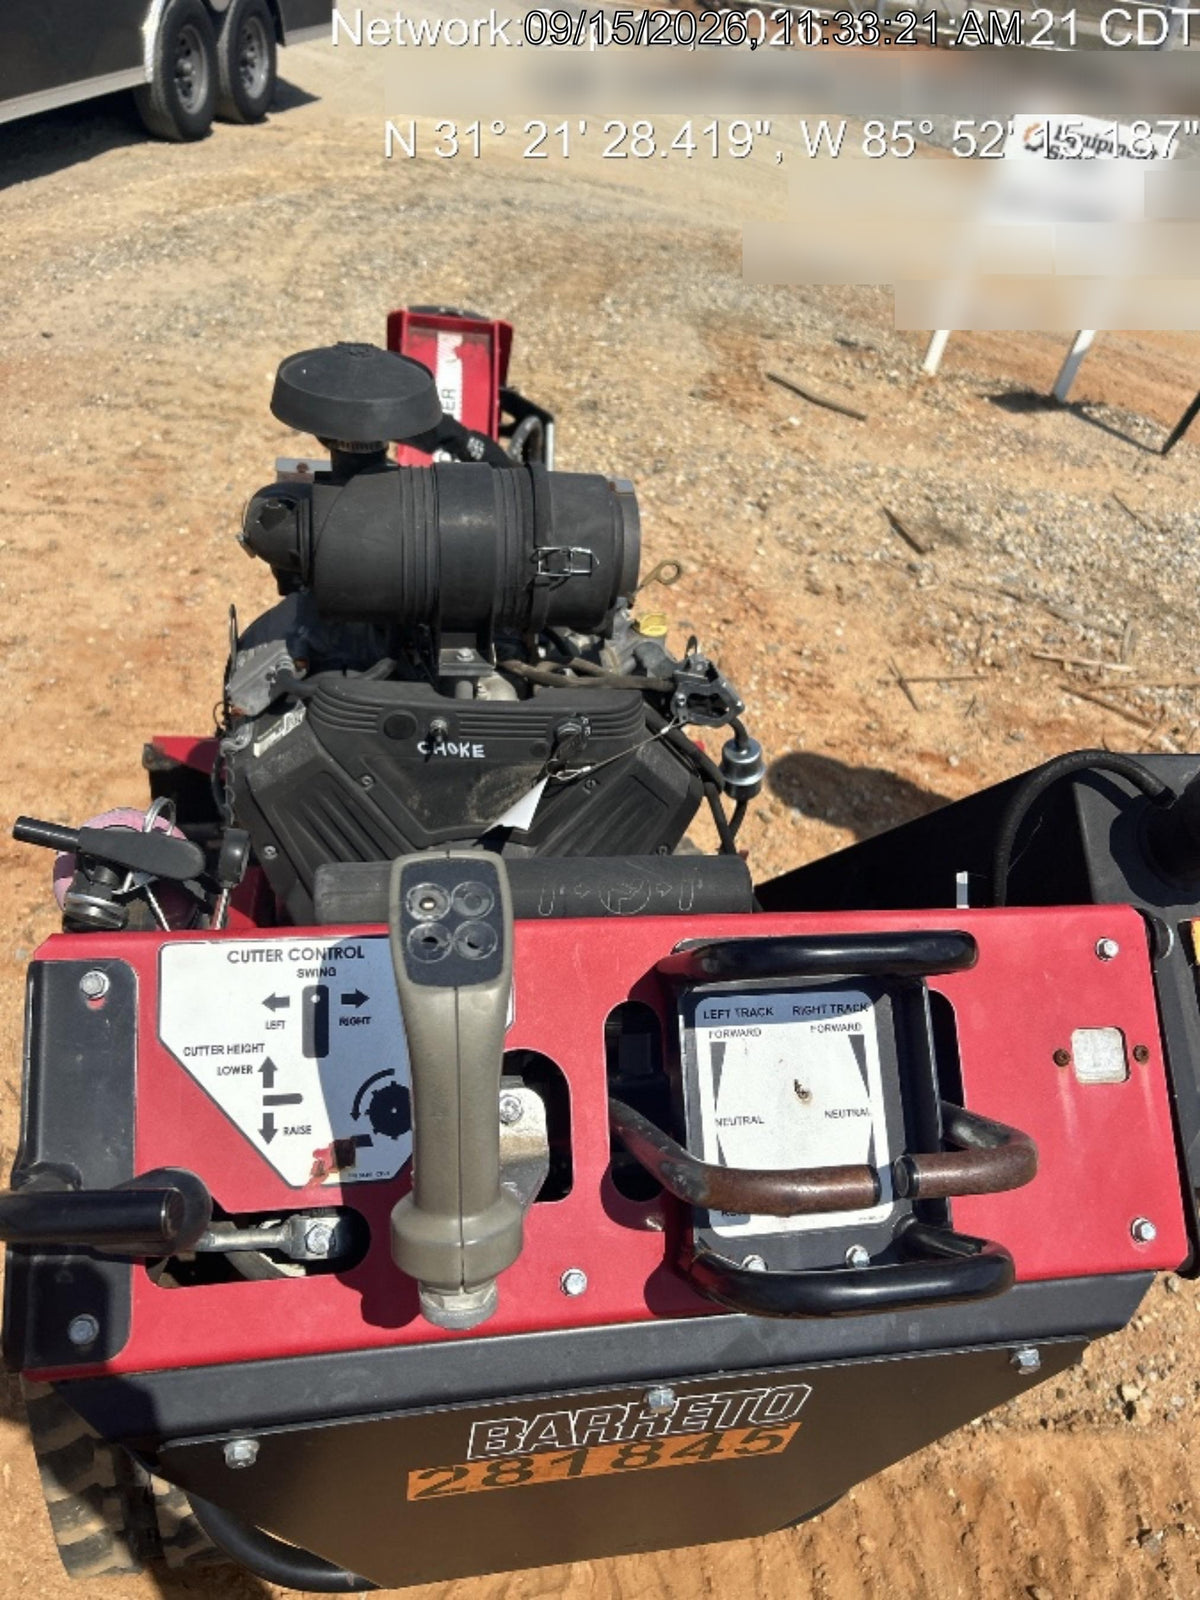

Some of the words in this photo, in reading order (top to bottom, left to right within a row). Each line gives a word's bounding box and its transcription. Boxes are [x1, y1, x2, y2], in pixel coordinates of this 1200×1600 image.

[417, 740, 486, 759] CHOKE
[227, 949, 284, 964] CUTTER
[288, 945, 365, 962] CONTROL
[296, 966, 337, 979] SWING
[702, 1008, 731, 1020] LEFT
[735, 1006, 774, 1019] TRACK
[792, 1004, 828, 1016] RIGHT
[830, 1002, 869, 1015] TRACK
[265, 1020, 286, 1031] LEFT
[338, 1015, 373, 1027] RIGHT
[708, 1028, 762, 1039] FORWARD
[809, 1022, 863, 1034] FORWARD
[183, 1045, 225, 1057] CUTTER
[226, 1043, 266, 1055] HEIGHT
[216, 1065, 253, 1076] LOWER
[824, 1107, 872, 1120] NEUTRAL
[715, 1115, 765, 1128] NEUTRAL
[283, 1125, 312, 1136] RAISE
[467, 1384, 812, 1460] BARRETO
[414, 1422, 791, 1499] 281845
